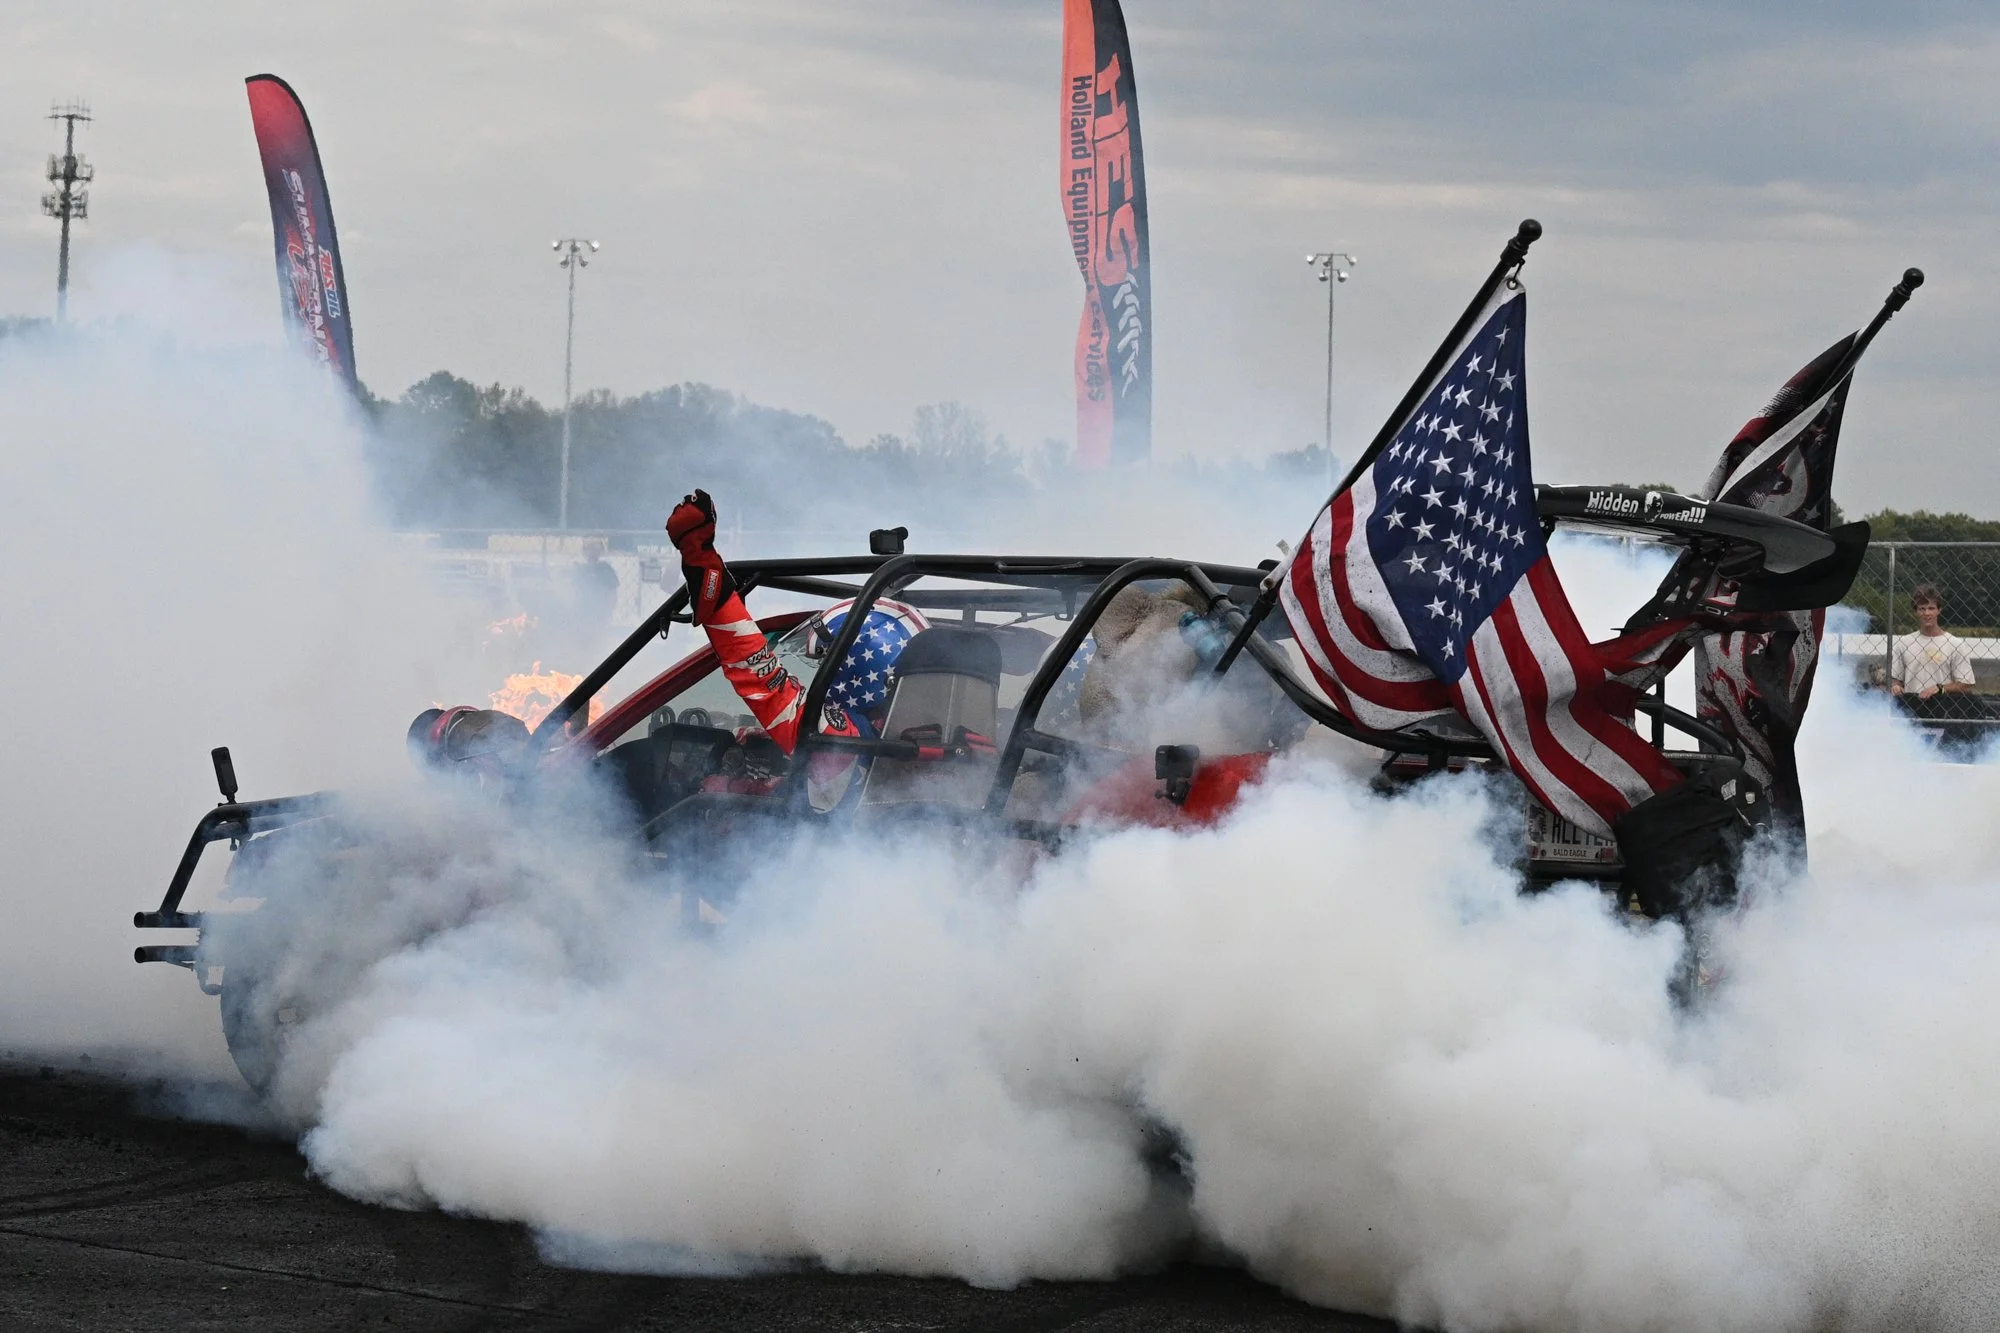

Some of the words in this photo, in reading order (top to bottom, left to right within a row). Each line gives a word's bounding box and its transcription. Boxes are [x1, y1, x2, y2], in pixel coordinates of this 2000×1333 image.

[1071, 75, 1093, 160] Holland
[319, 245, 340, 318] AMSOIL
[1587, 491, 1639, 514] Hidden
[1660, 507, 1706, 524] POWER!!!
[1553, 848, 1568, 857] BALD
[1569, 849, 1587, 857] EAGLE
